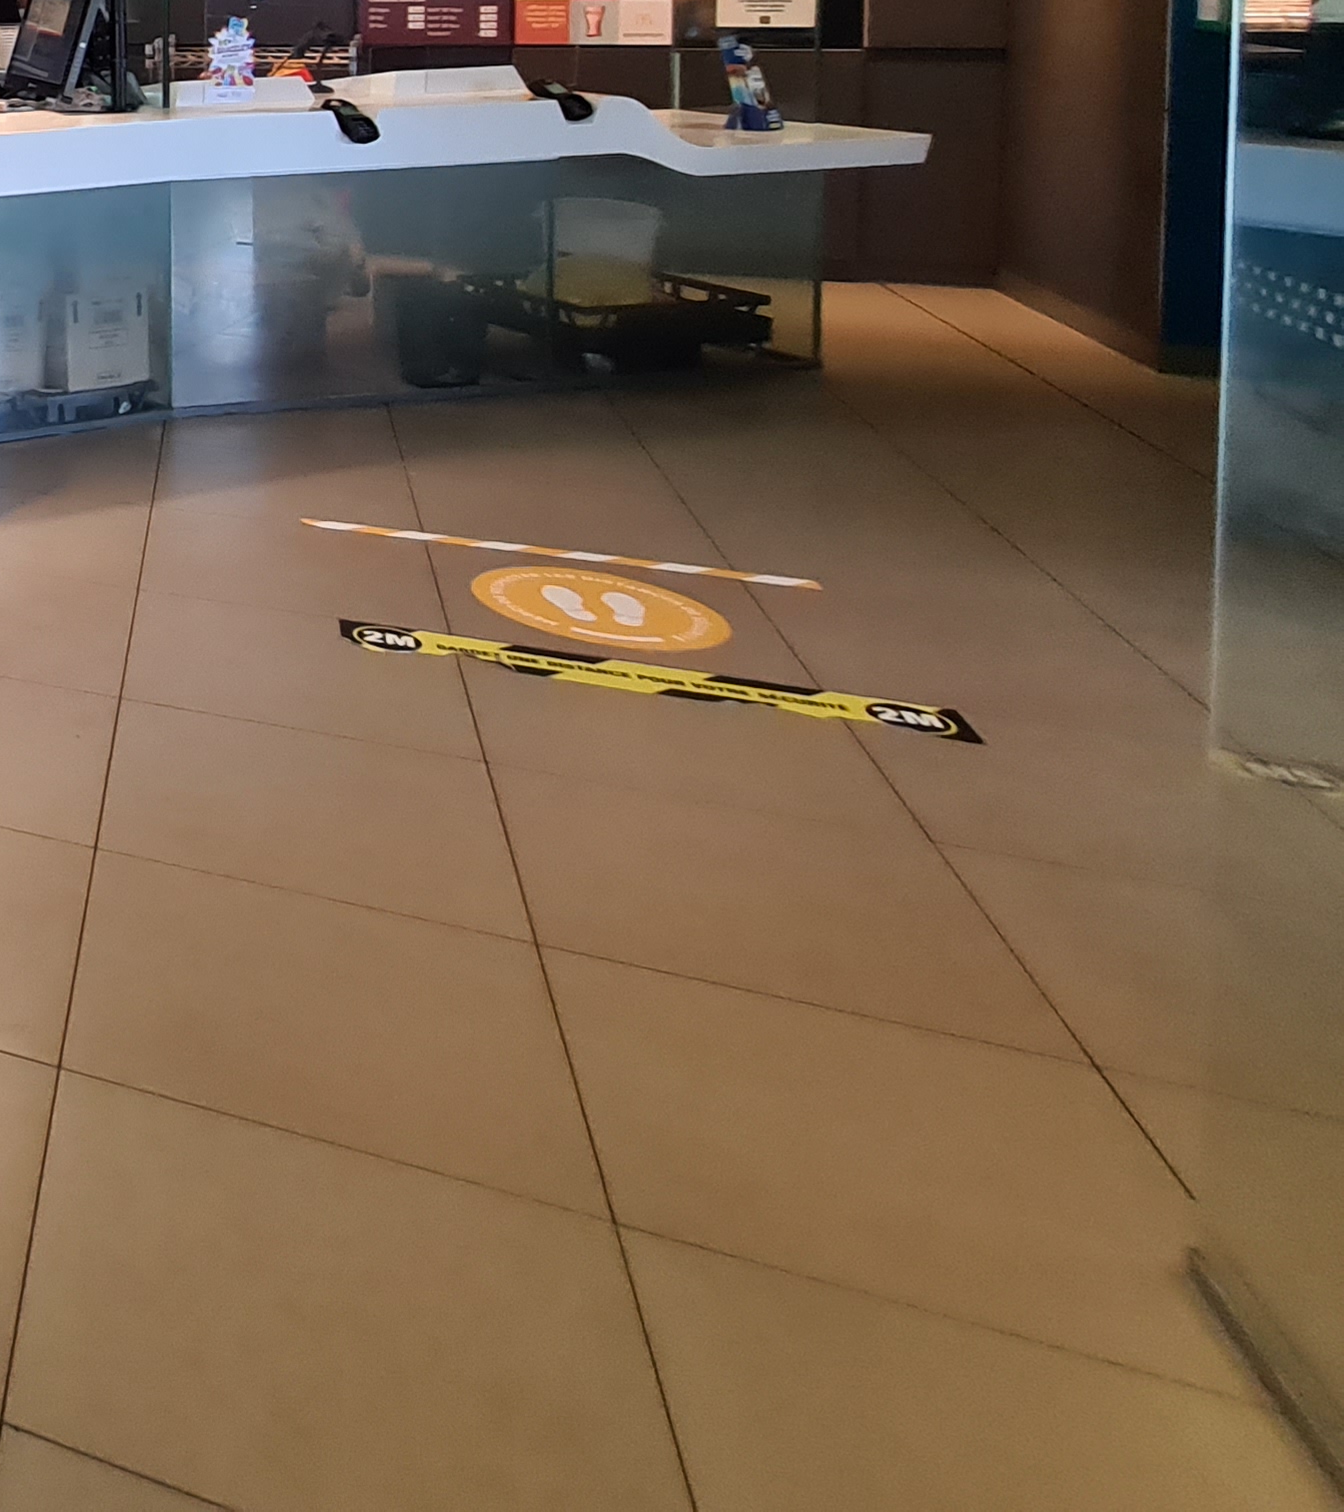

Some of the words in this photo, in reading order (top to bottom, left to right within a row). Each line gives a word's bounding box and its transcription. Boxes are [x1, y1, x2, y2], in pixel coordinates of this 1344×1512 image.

[362, 630, 417, 648] 2M
[546, 660, 632, 678] DISTANCE
[637, 673, 686, 686] POUR
[871, 706, 945, 729] 2M
